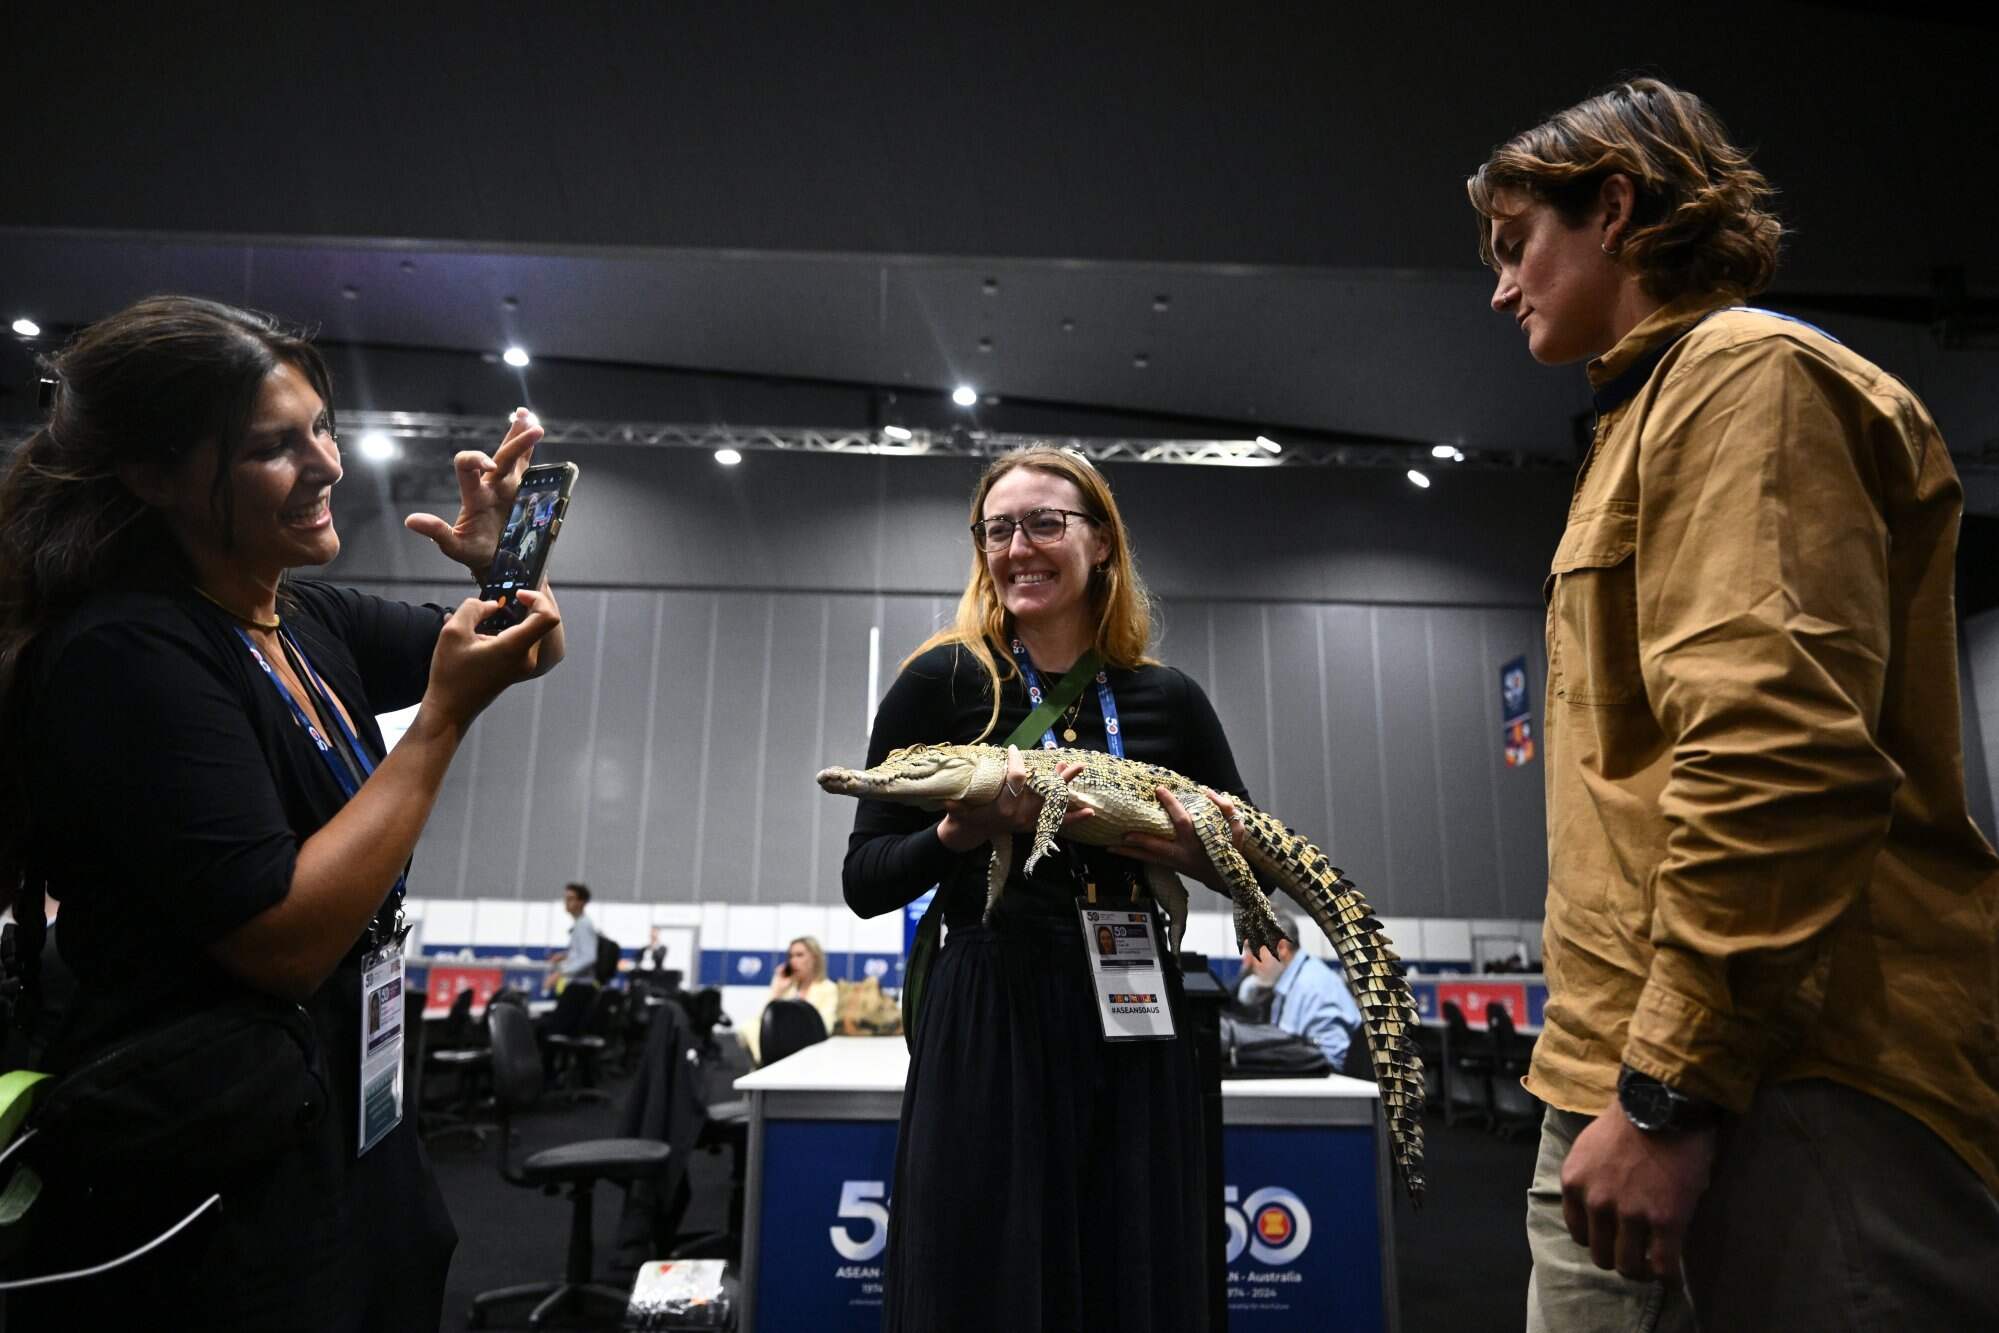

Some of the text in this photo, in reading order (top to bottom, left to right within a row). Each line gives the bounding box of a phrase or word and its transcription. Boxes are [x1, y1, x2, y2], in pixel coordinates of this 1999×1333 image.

[1111, 1006, 1160, 1014] #ASEAN50AUS
[829, 1181, 891, 1261] 5
[835, 1266, 880, 1278] ASEAN
[1247, 1271, 1302, 1283] Australia
[1251, 1287, 1277, 1298] 2024
